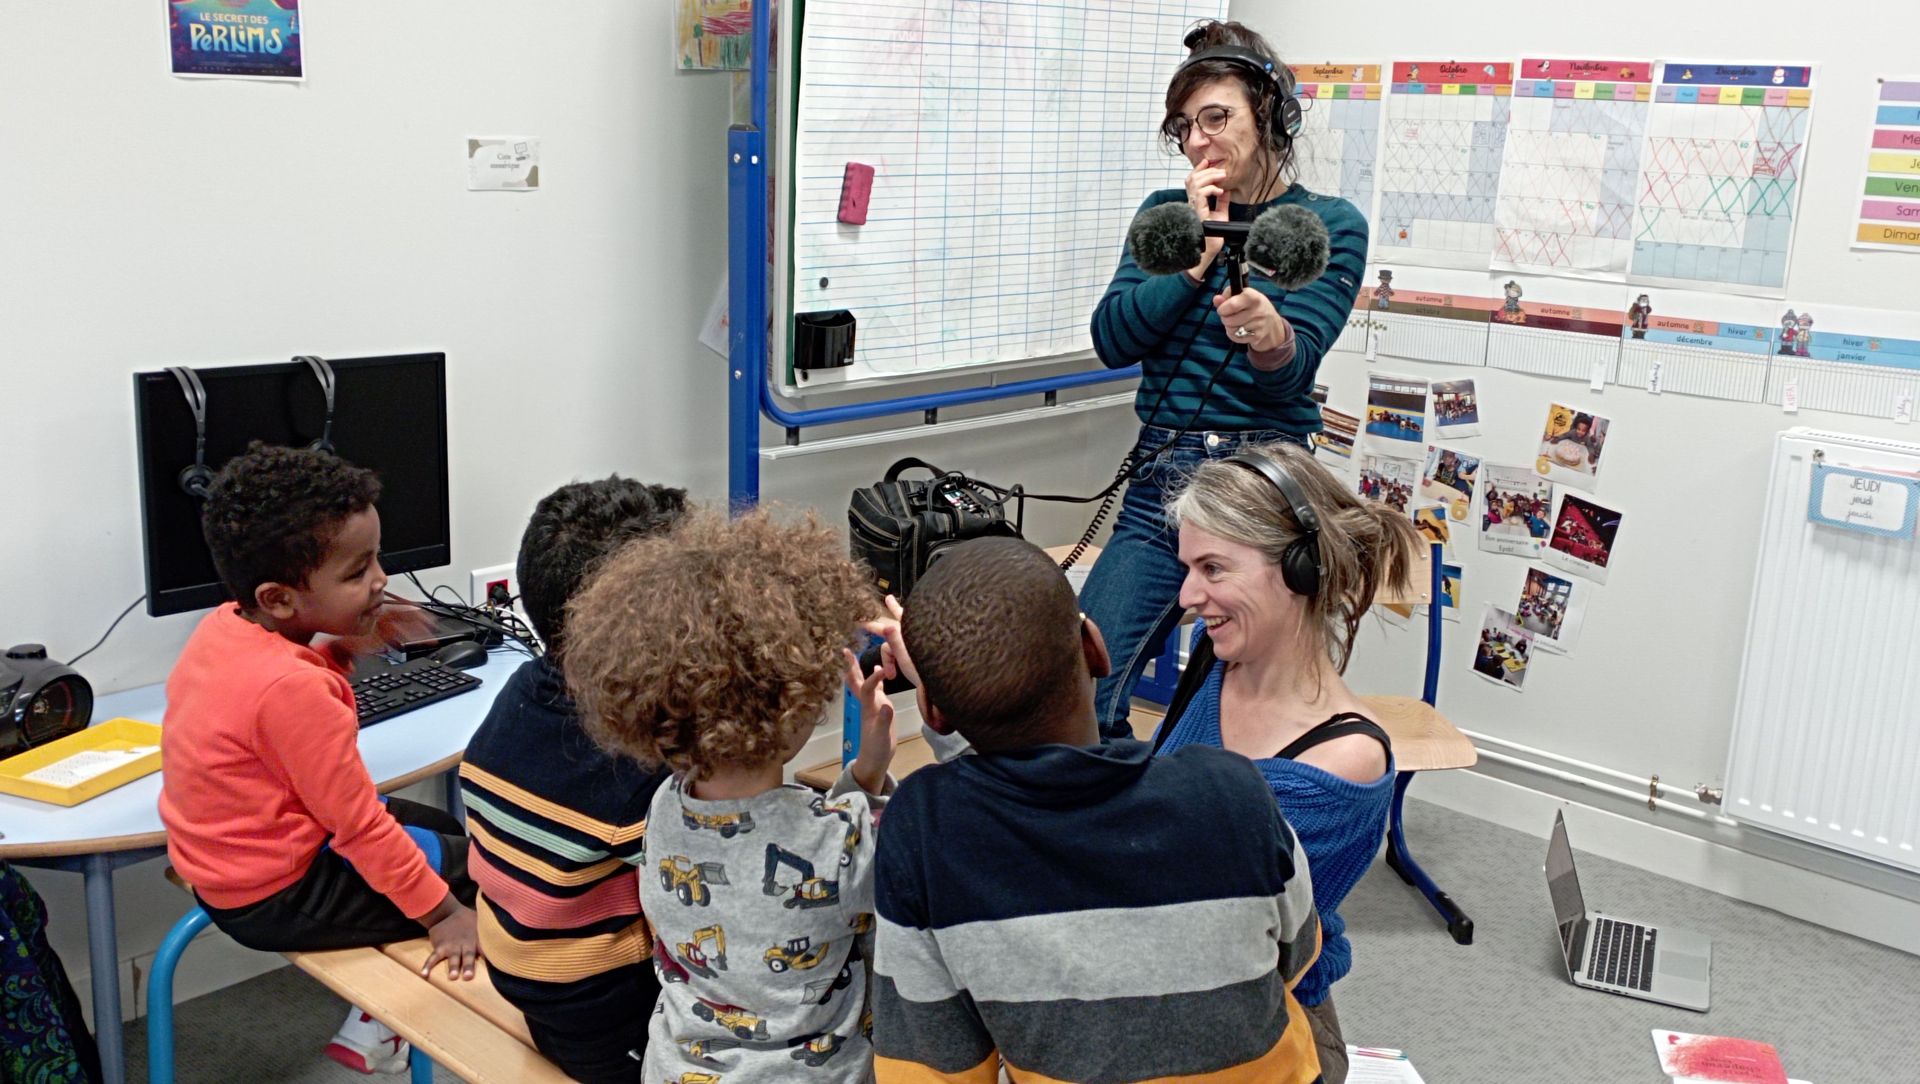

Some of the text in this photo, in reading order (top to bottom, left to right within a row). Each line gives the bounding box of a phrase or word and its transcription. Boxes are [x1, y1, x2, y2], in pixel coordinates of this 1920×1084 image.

[200, 12, 269, 24] LE SECRET DES
[1313, 66, 1344, 75] Septembre
[1439, 64, 1468, 73] Octobre
[1895, 181, 1920, 193] Ven
[1416, 295, 1442, 304] automne
[1541, 308, 1570, 316] automne
[1657, 321, 1747, 336] automne hiver
[1676, 335, 1713, 346] décembre
[1842, 338, 1865, 347] hiver
[1837, 351, 1867, 361] janvier
[1850, 477, 1881, 493] JEUDI
[1849, 493, 1873, 506] jeudi
